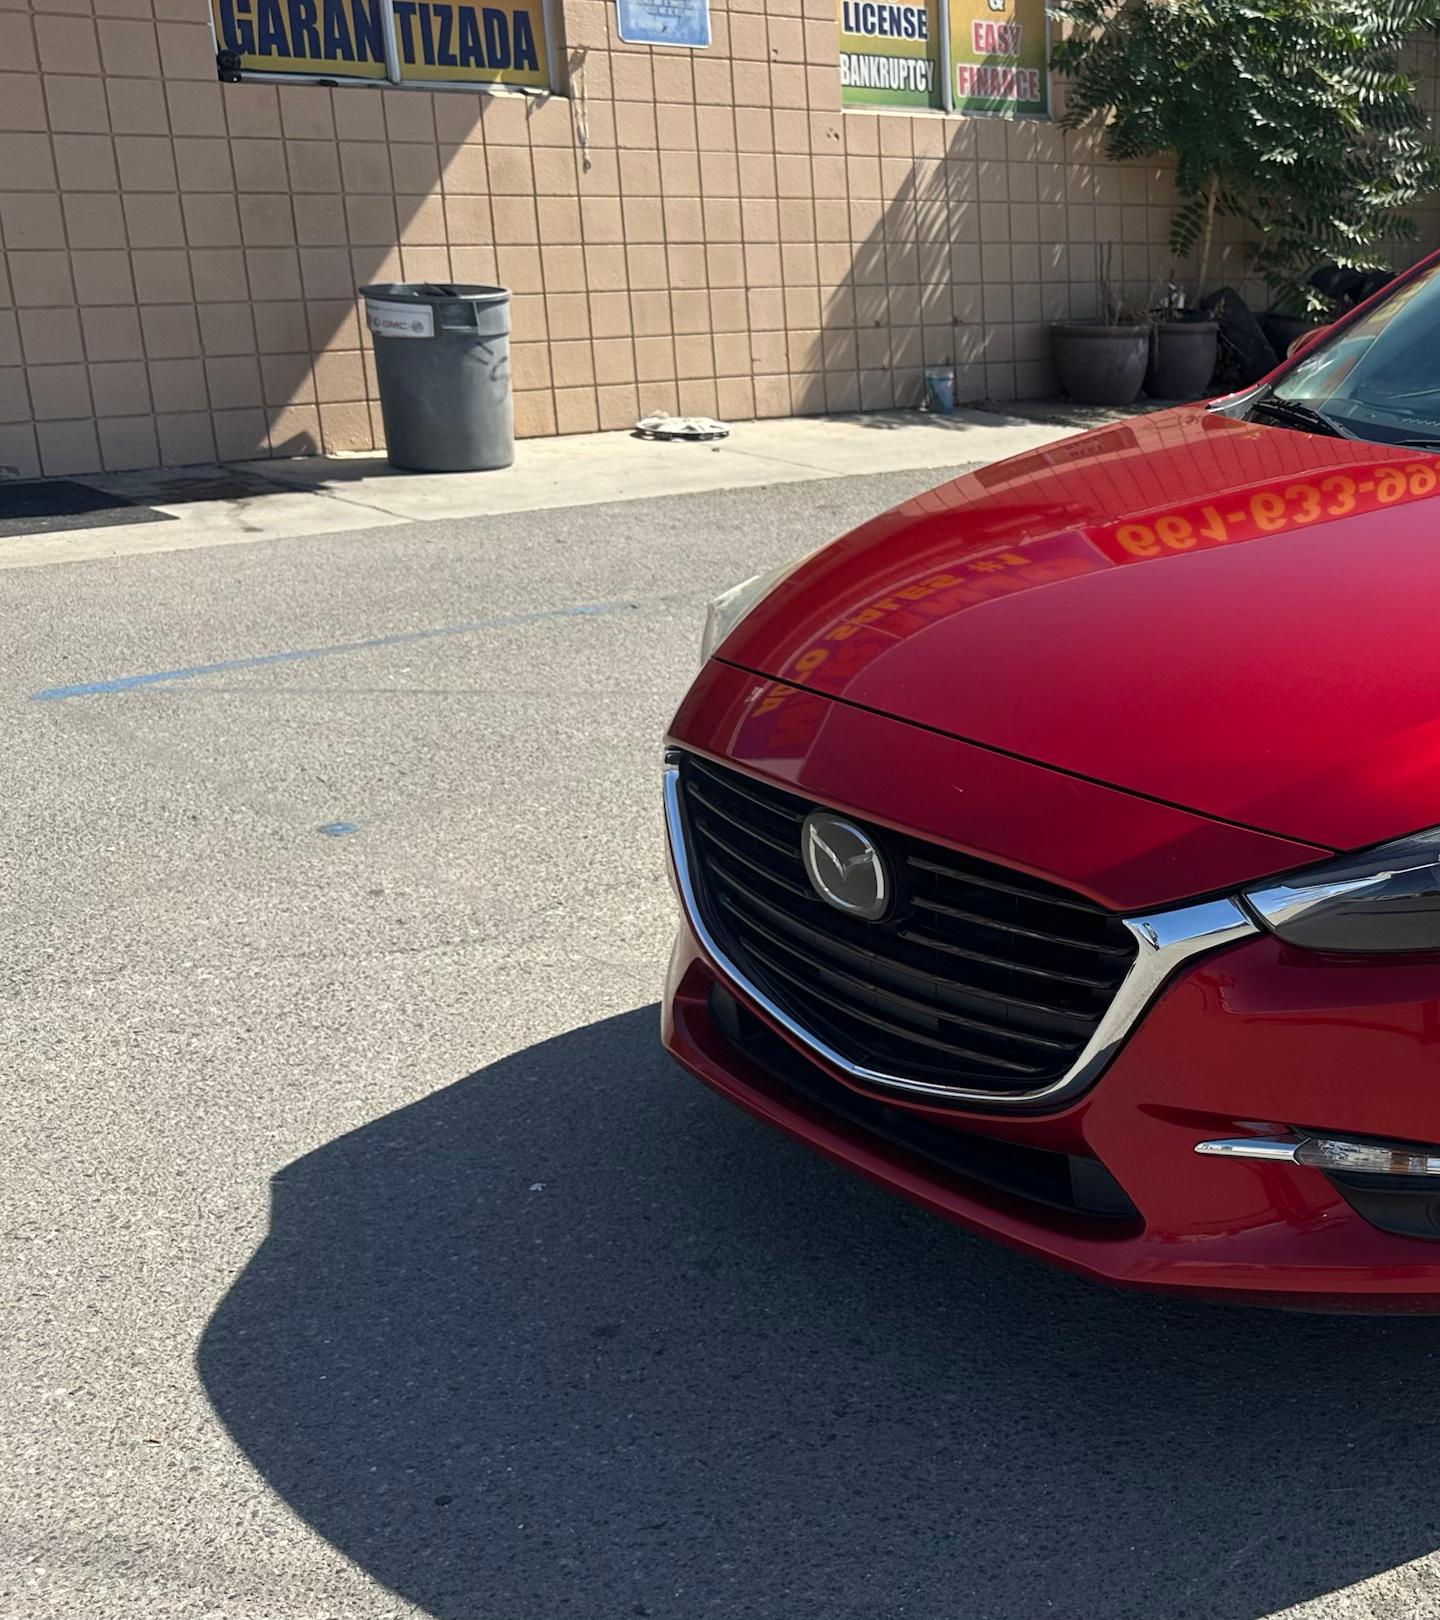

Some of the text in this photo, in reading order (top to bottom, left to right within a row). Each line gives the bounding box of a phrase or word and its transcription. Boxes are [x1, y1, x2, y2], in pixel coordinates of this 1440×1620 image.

[843, 1, 929, 41] LICENSE
[972, 20, 1022, 56] EASY
[840, 52, 935, 93] BANKRUPTCY
[957, 63, 1040, 102] FINANCE
